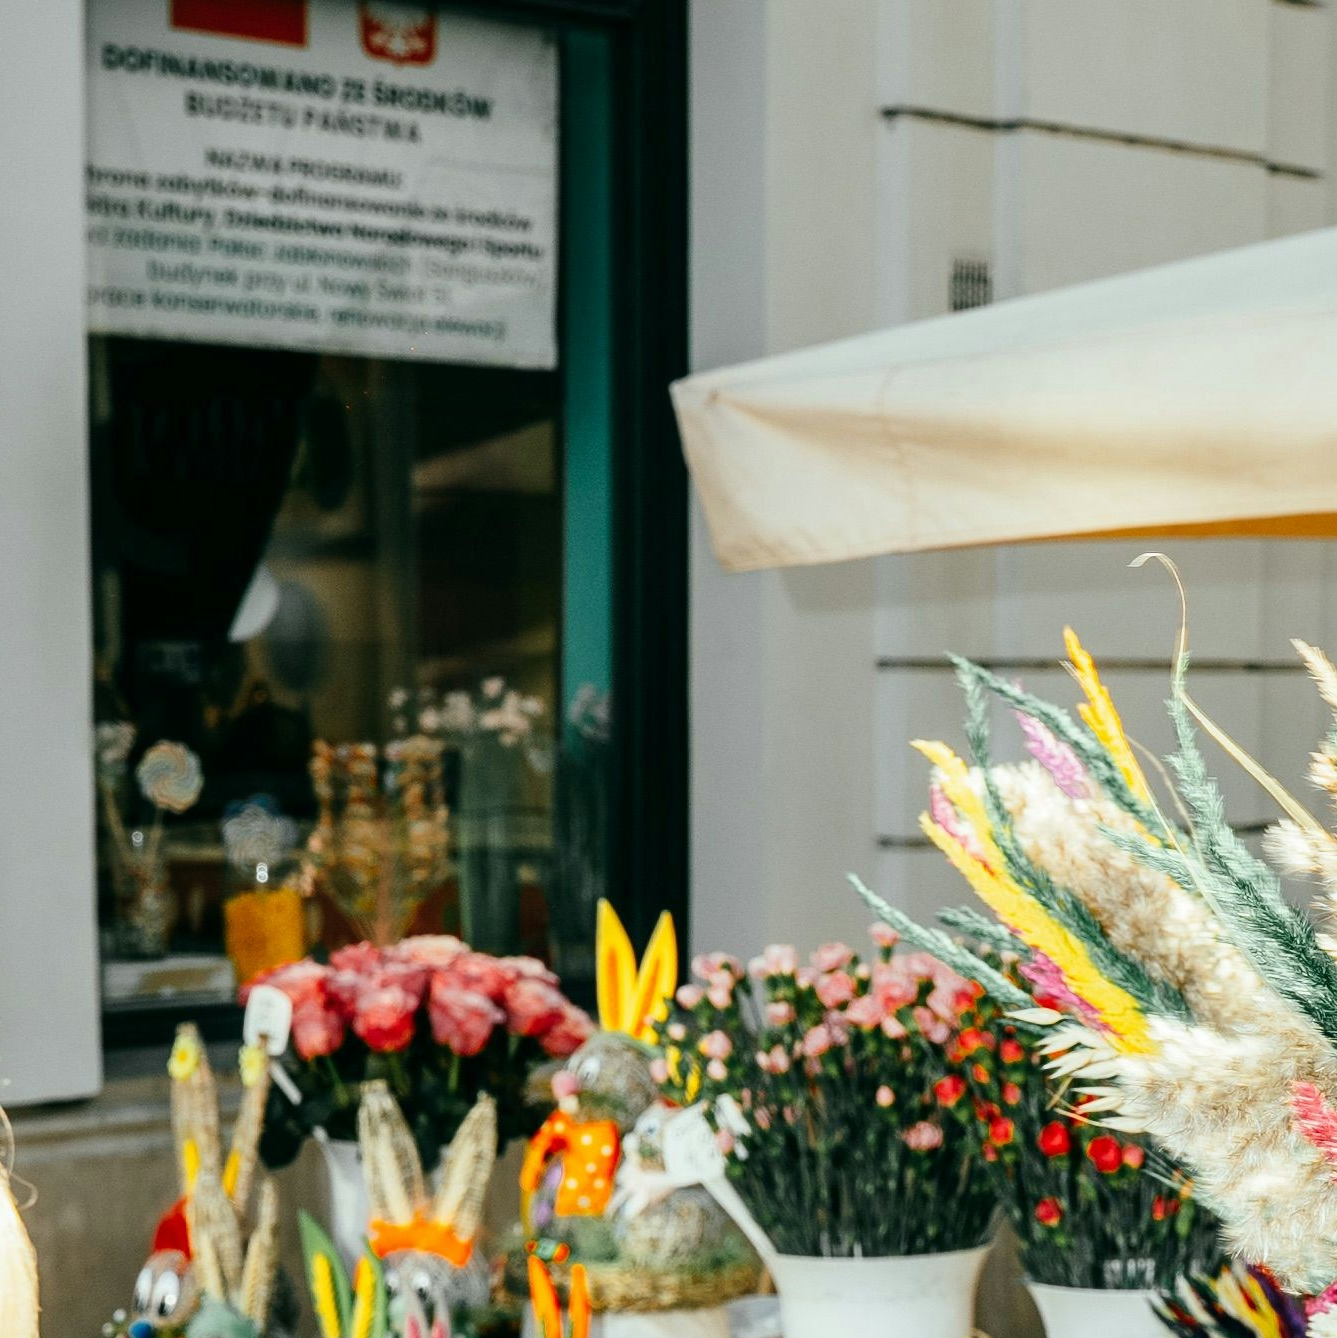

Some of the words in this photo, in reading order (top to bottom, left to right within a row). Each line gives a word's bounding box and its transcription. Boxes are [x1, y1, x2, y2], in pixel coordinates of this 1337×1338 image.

[101, 42, 337, 99] DOFINANSOWANO
[373, 73, 495, 121] ŚRODKÓW
[184, 89, 298, 129] BUDŻETU
[302, 104, 423, 143] PAŃSTWA
